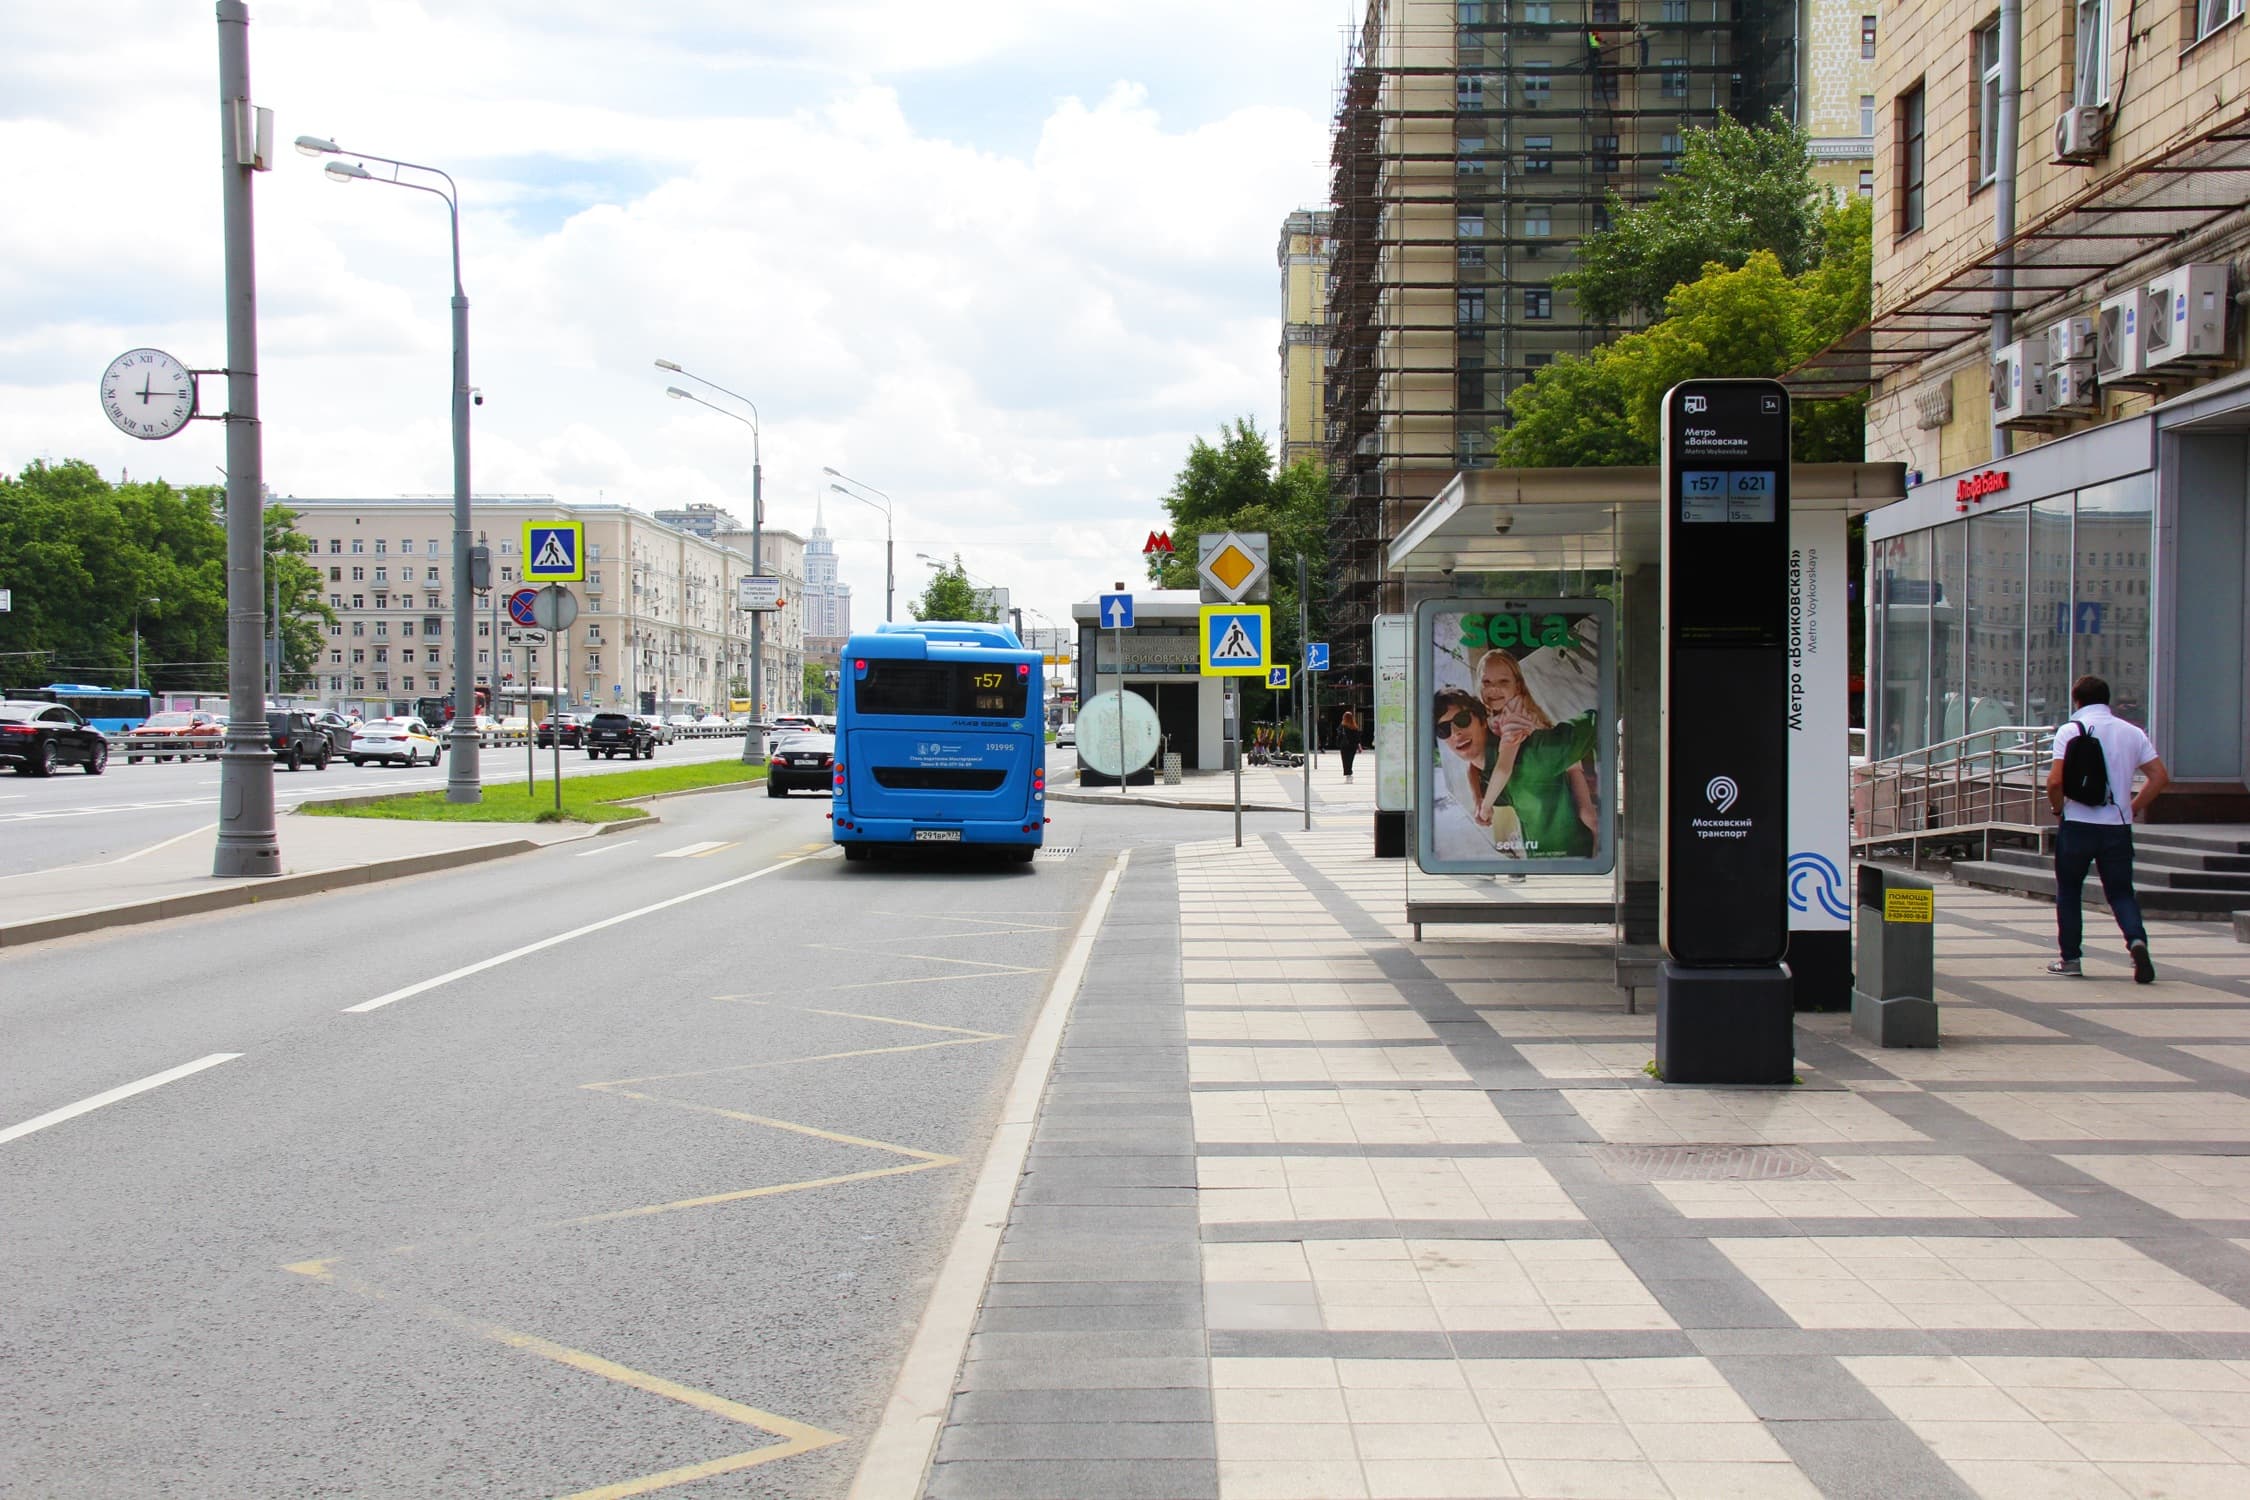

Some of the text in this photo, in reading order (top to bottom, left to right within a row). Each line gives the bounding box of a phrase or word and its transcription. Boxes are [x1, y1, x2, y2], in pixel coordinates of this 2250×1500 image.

[1684, 427, 1717, 437] Метро
[1684, 437, 1749, 446] «Войковская»
[1738, 476, 1766, 491] 621
[1683, 511, 1692, 520] 0
[1731, 511, 1742, 520] 15
[1807, 548, 1819, 654] Metro Voykovskaya
[1459, 612, 1577, 649] sela
[1788, 672, 1805, 732] Метро
[985, 743, 1015, 752] 191995
[1691, 817, 1753, 828] Московский
[1696, 830, 1748, 840] транспорт
[1888, 893, 1929, 901] ПОМОЩЬ
